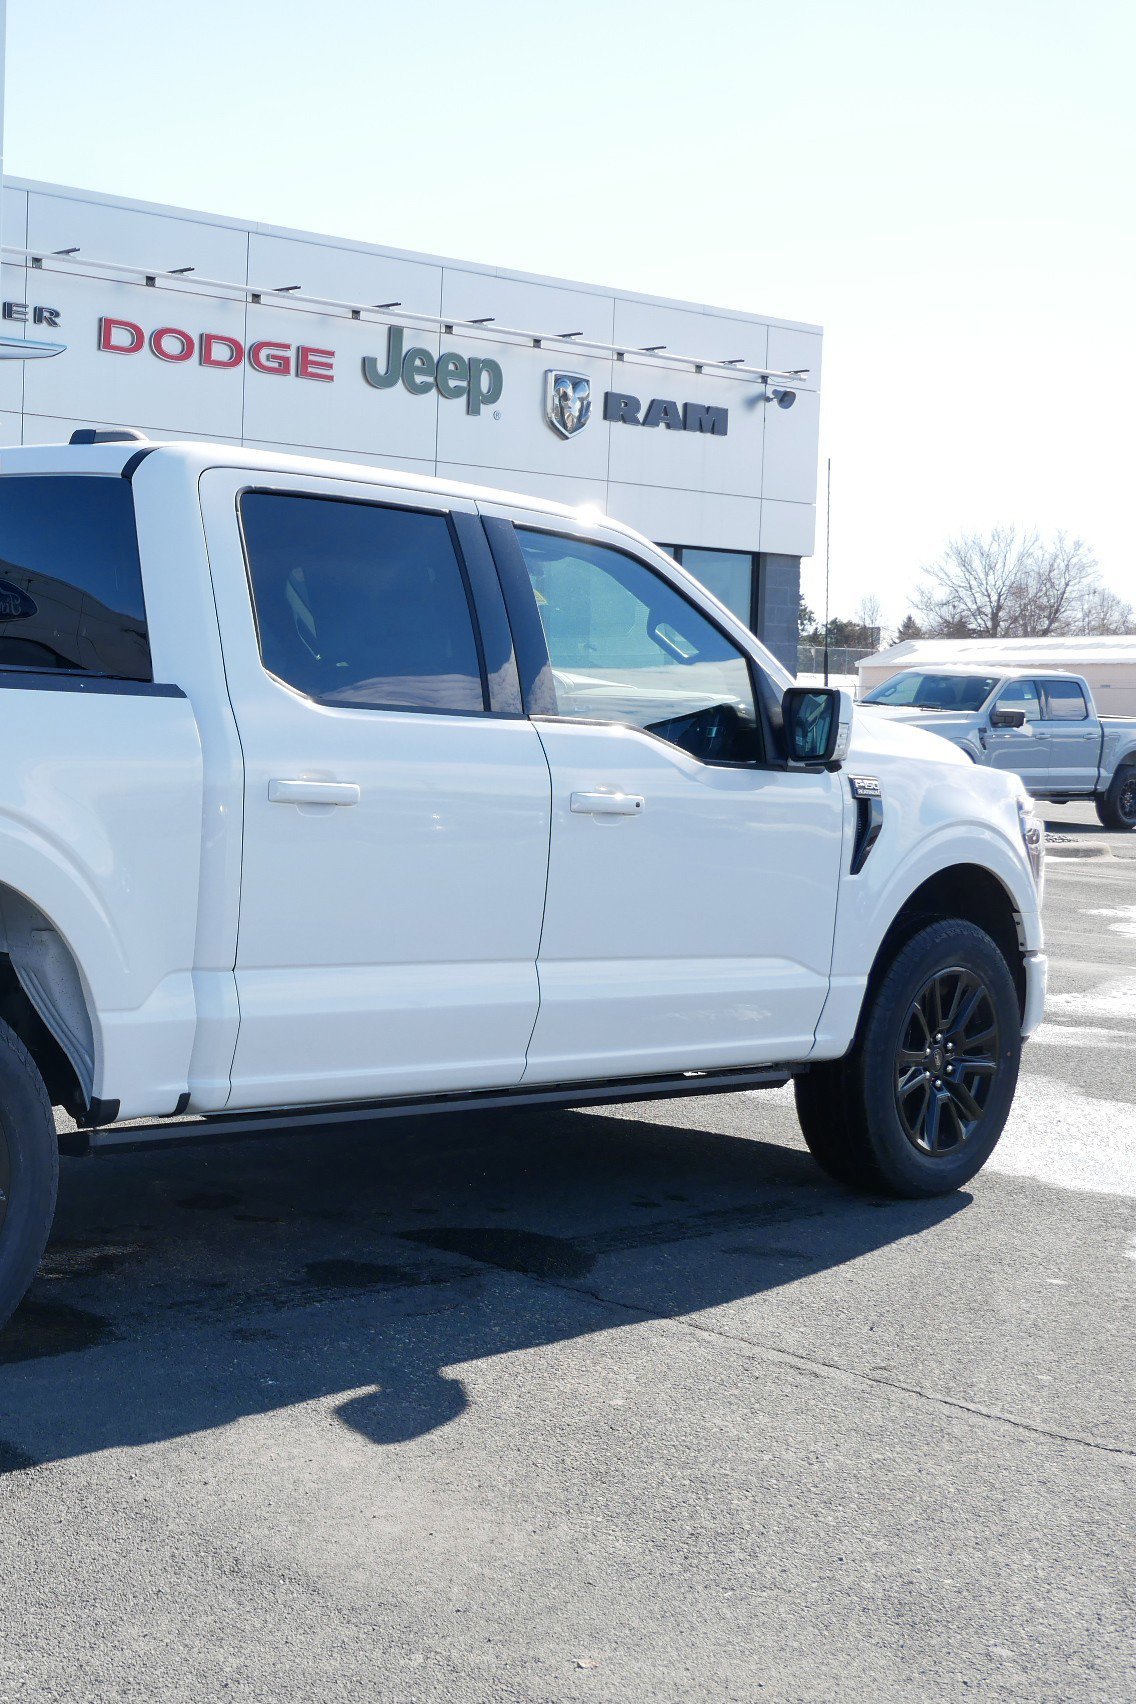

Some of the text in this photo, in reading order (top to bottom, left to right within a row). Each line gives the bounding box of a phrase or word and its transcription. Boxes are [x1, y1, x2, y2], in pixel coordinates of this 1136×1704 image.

[98, 316, 335, 383] DODGE
[361, 325, 503, 416] Jeep
[603, 391, 728, 436] RAM
